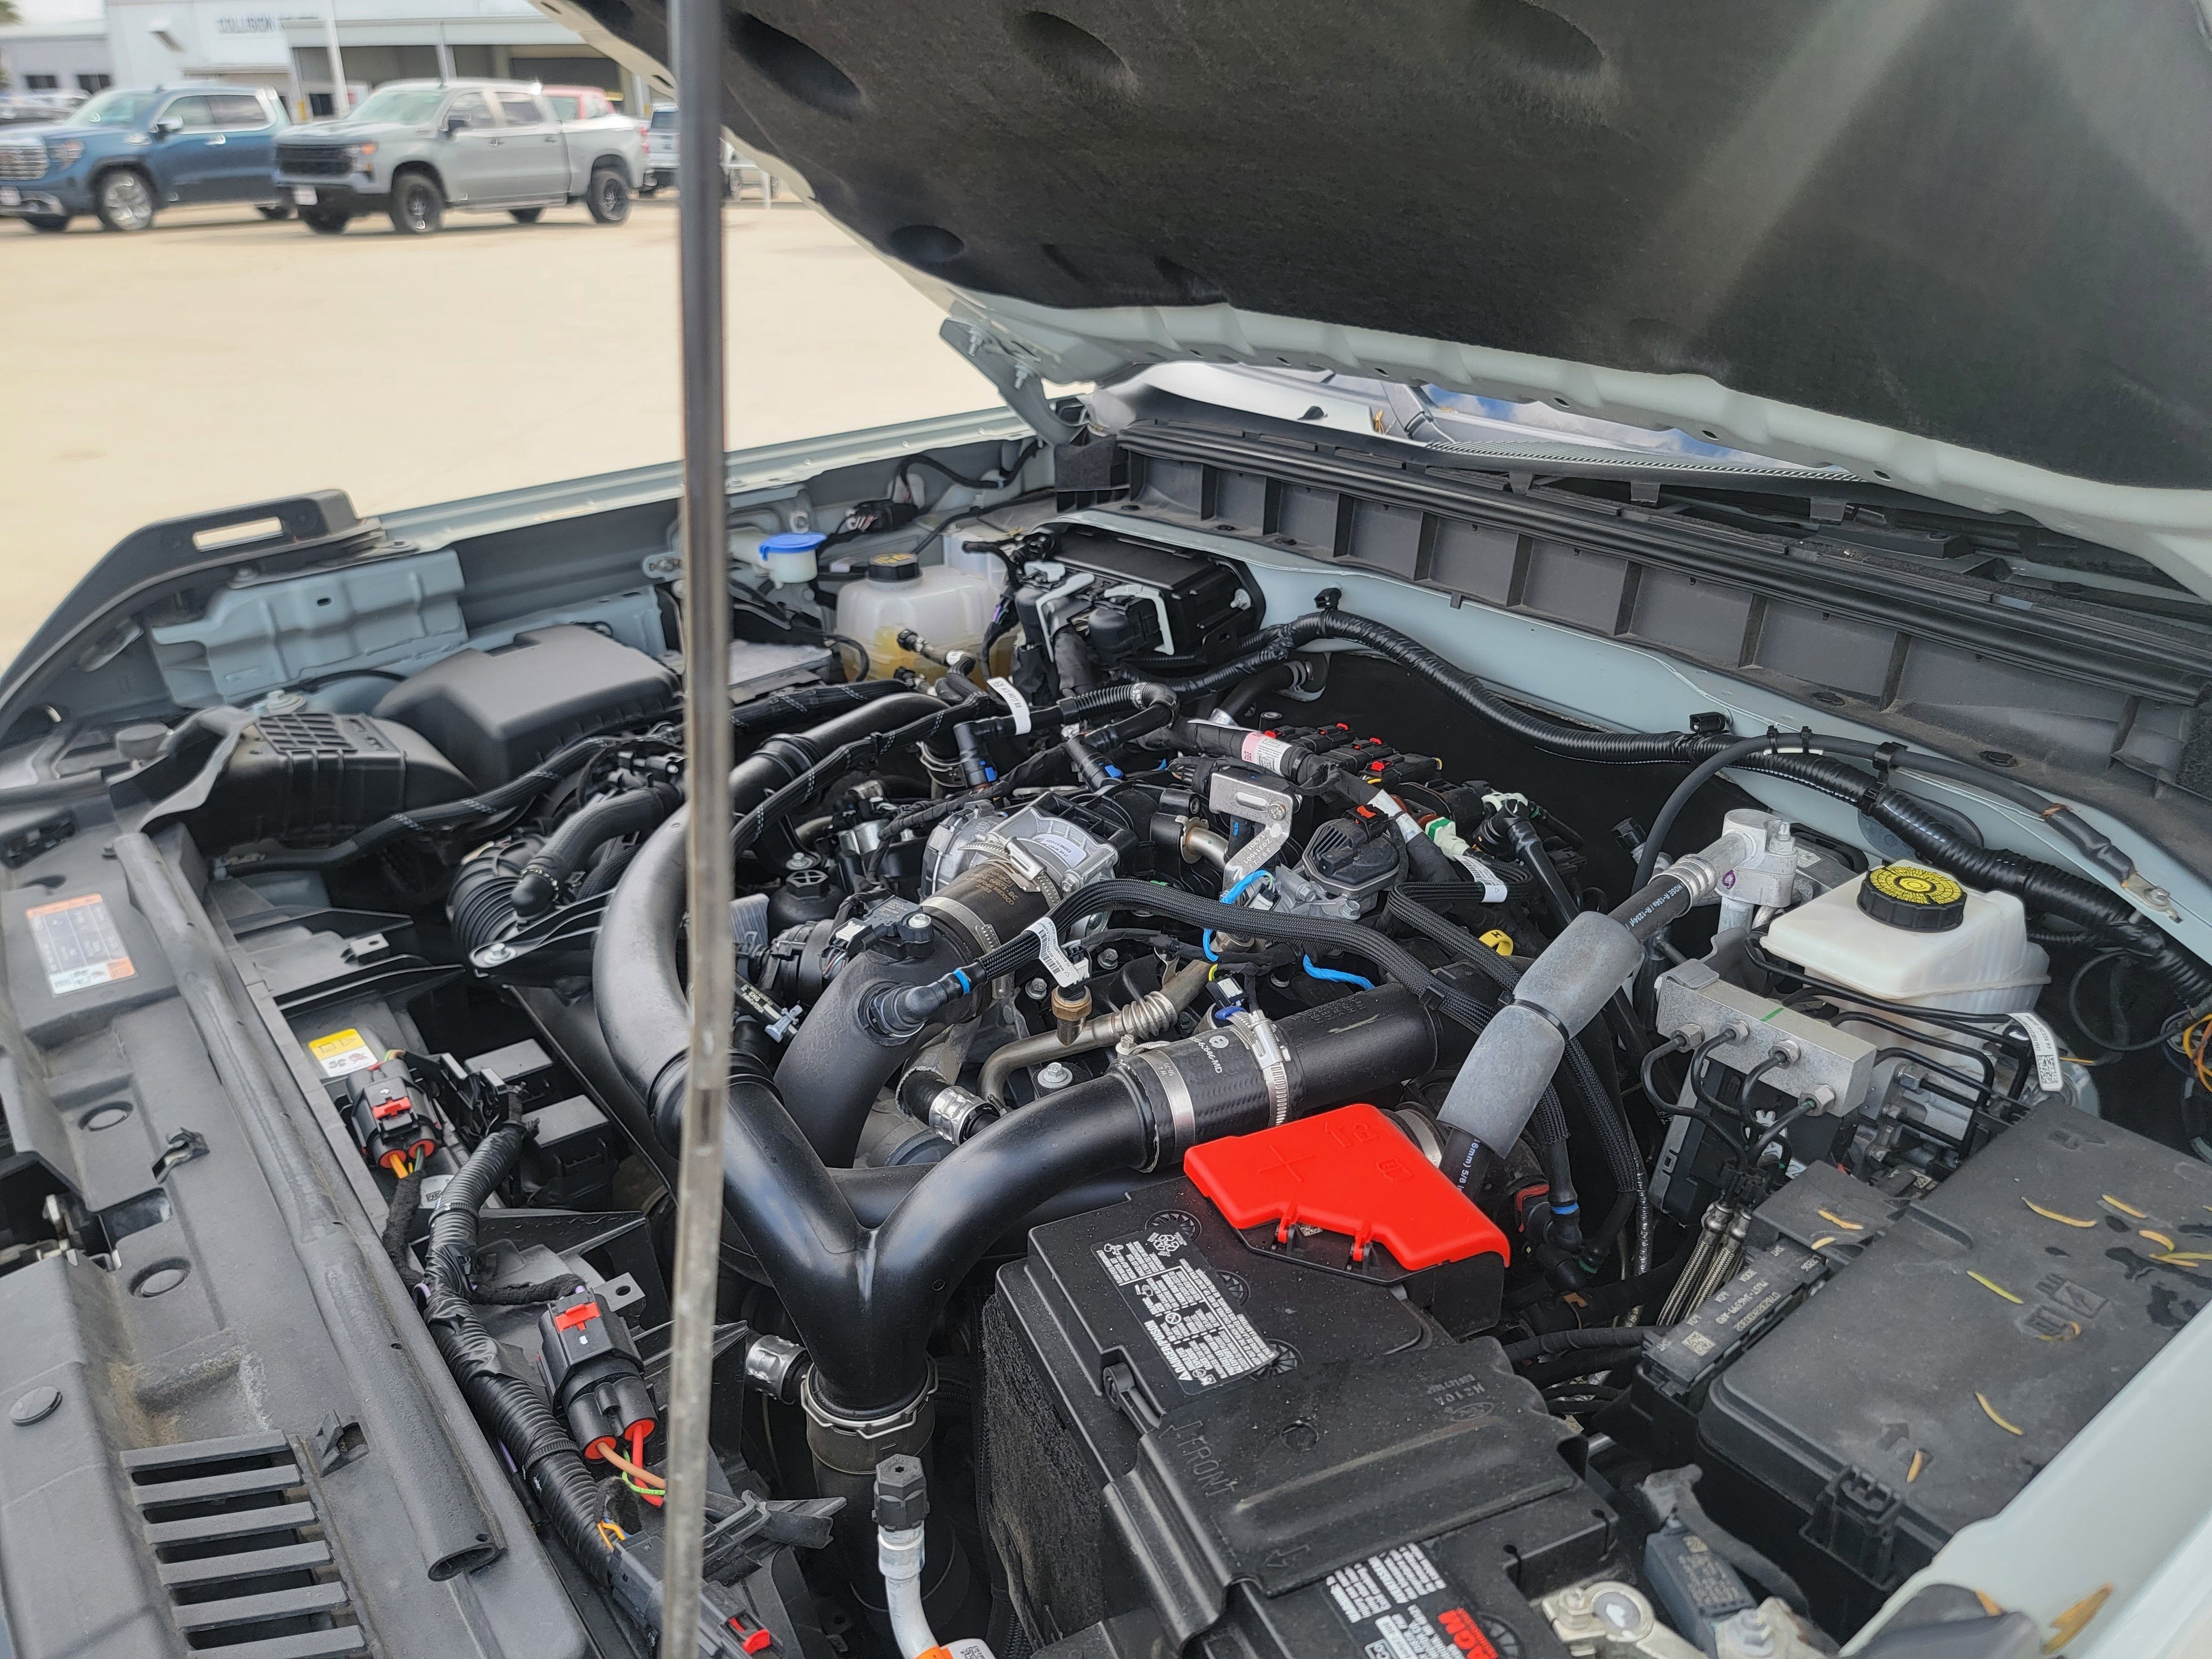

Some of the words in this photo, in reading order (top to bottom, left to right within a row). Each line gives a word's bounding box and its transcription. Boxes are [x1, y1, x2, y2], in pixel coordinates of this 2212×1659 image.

[1242, 750, 1253, 761] BEC
[993, 886, 1015, 905] MEXICO
[1667, 883, 1683, 896] HOSE
[1652, 893, 1670, 908] R-134a
[1627, 906, 1652, 927] R-1234yf
[1053, 938, 1067, 962] AUTOMOTIVE
[1459, 1170, 1469, 1183] 5/8
[1144, 1319, 1186, 1374] DANGER/POISON
[1176, 1433, 1235, 1496] FRONT
